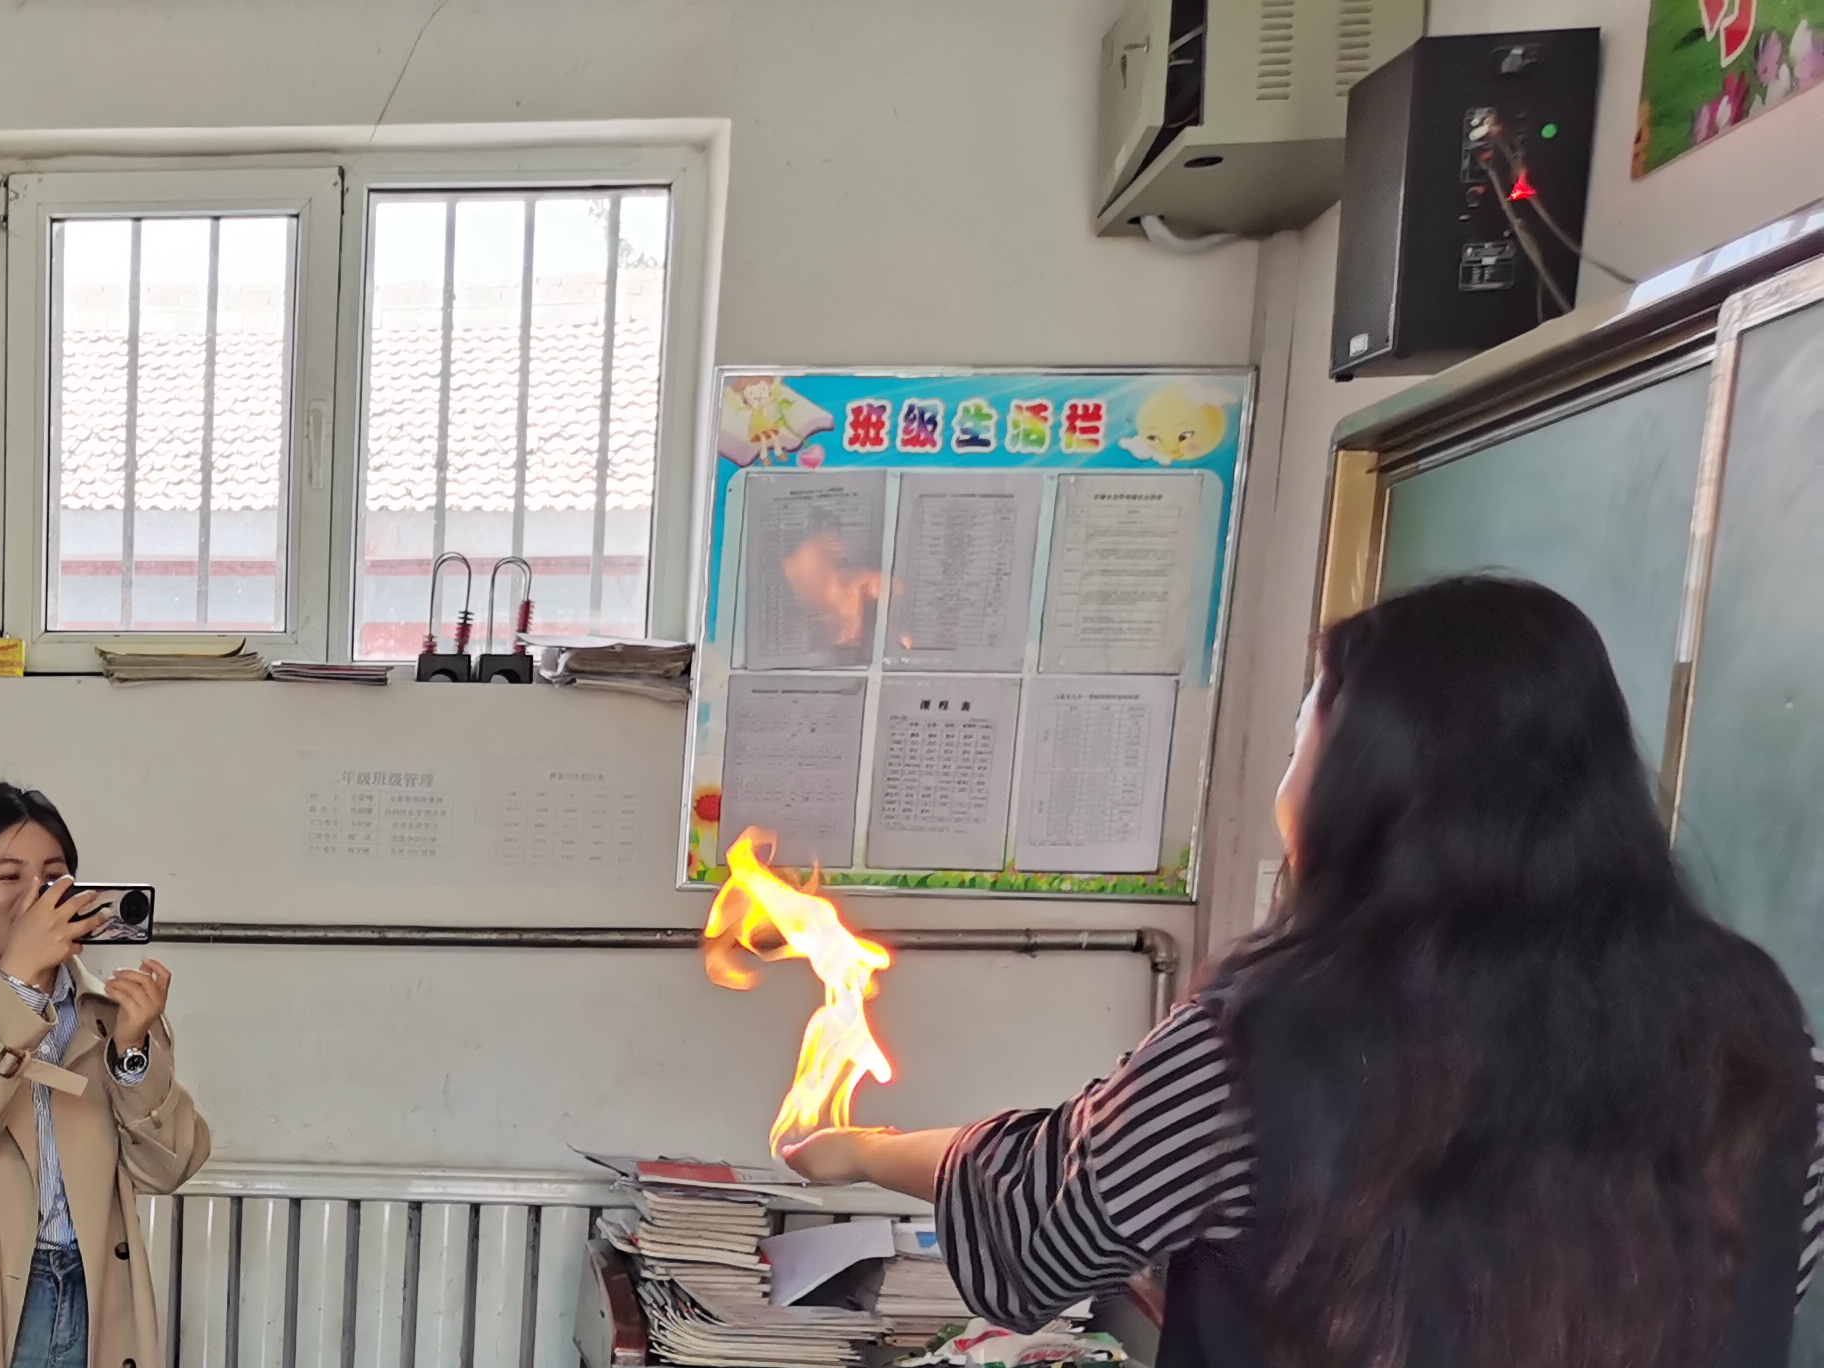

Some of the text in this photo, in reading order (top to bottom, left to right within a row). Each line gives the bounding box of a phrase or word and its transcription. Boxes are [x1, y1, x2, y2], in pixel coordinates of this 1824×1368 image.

[845, 400, 1103, 451] 班级生活栏
